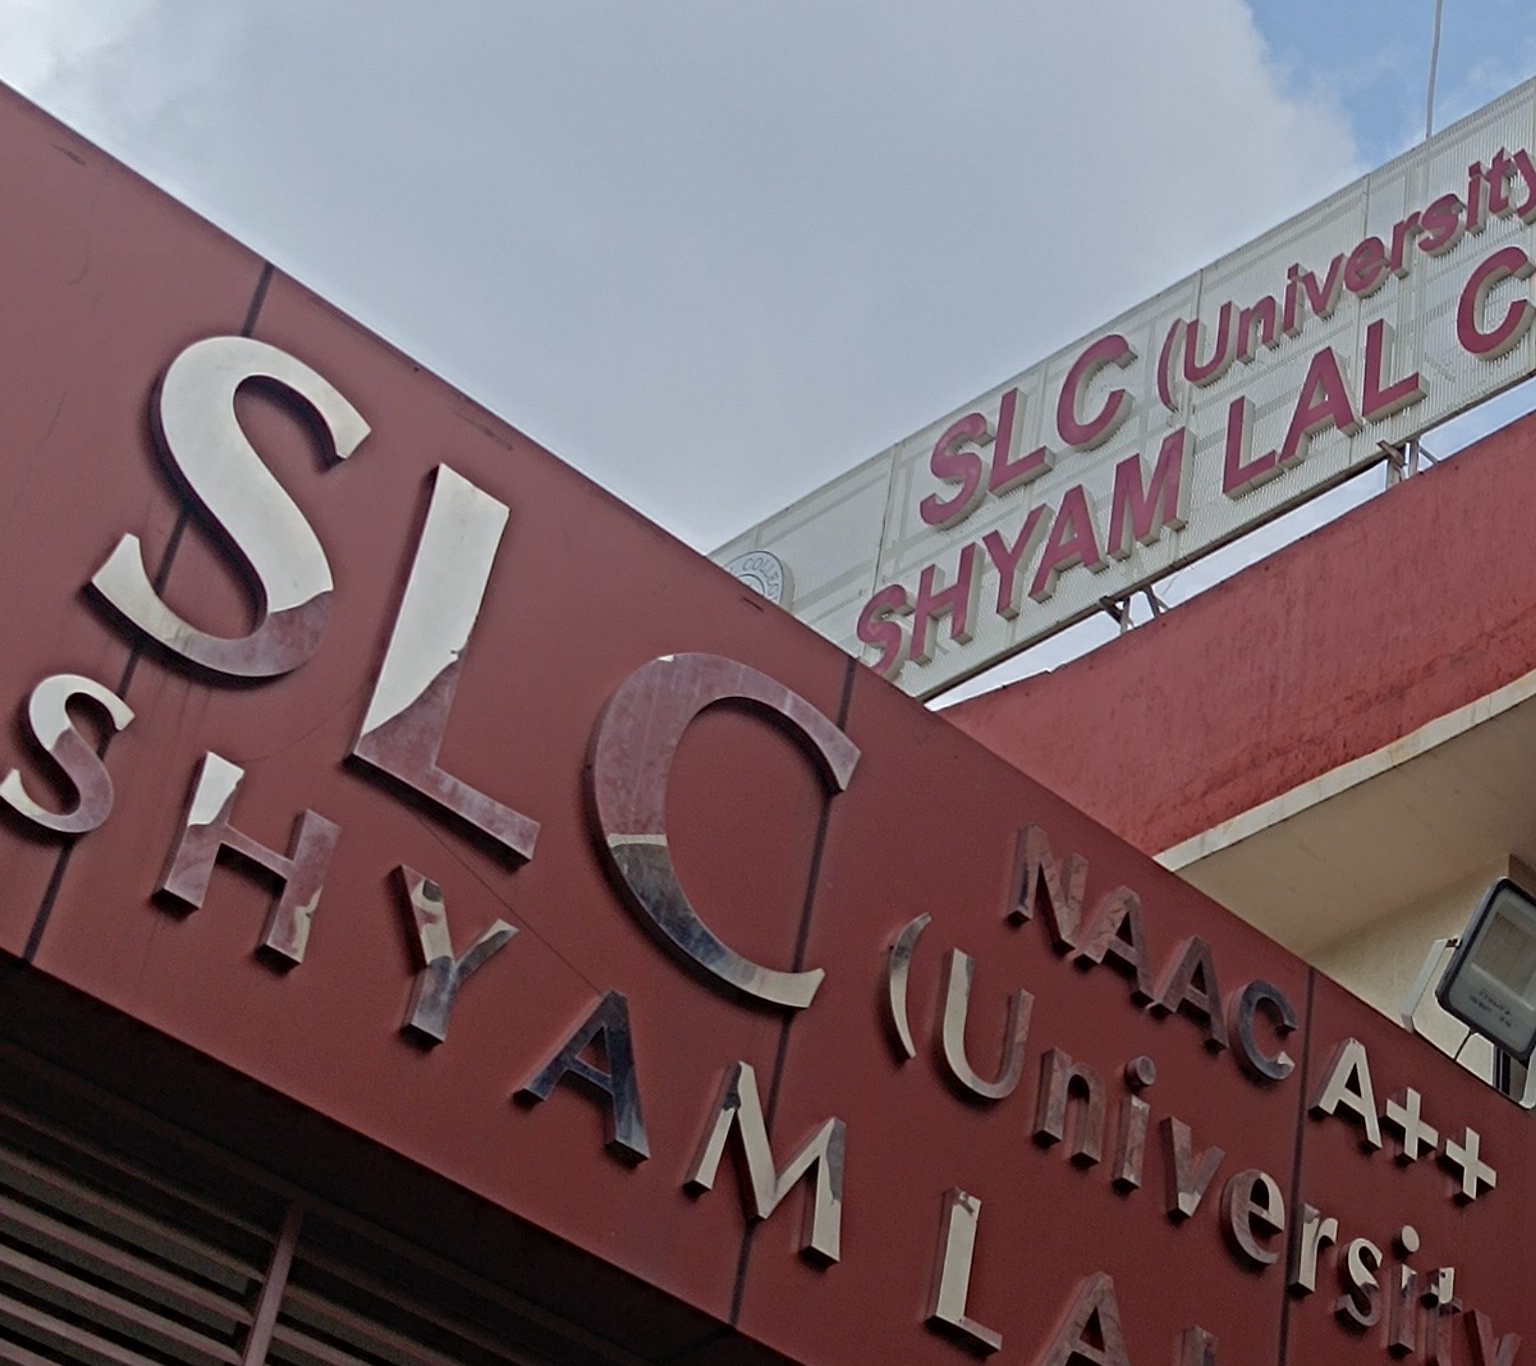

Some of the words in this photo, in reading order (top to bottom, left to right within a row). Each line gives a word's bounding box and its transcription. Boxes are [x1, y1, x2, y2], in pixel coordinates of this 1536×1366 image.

[856, 426, 1194, 681] SHYAM
[1222, 318, 1428, 499] LAL
[919, 333, 1137, 530] SLC
[90, 335, 862, 1009] SLC
[0, 673, 849, 1265] SHYAM
[1006, 824, 1297, 1080] NAAC
[1309, 1037, 1497, 1202] A++
